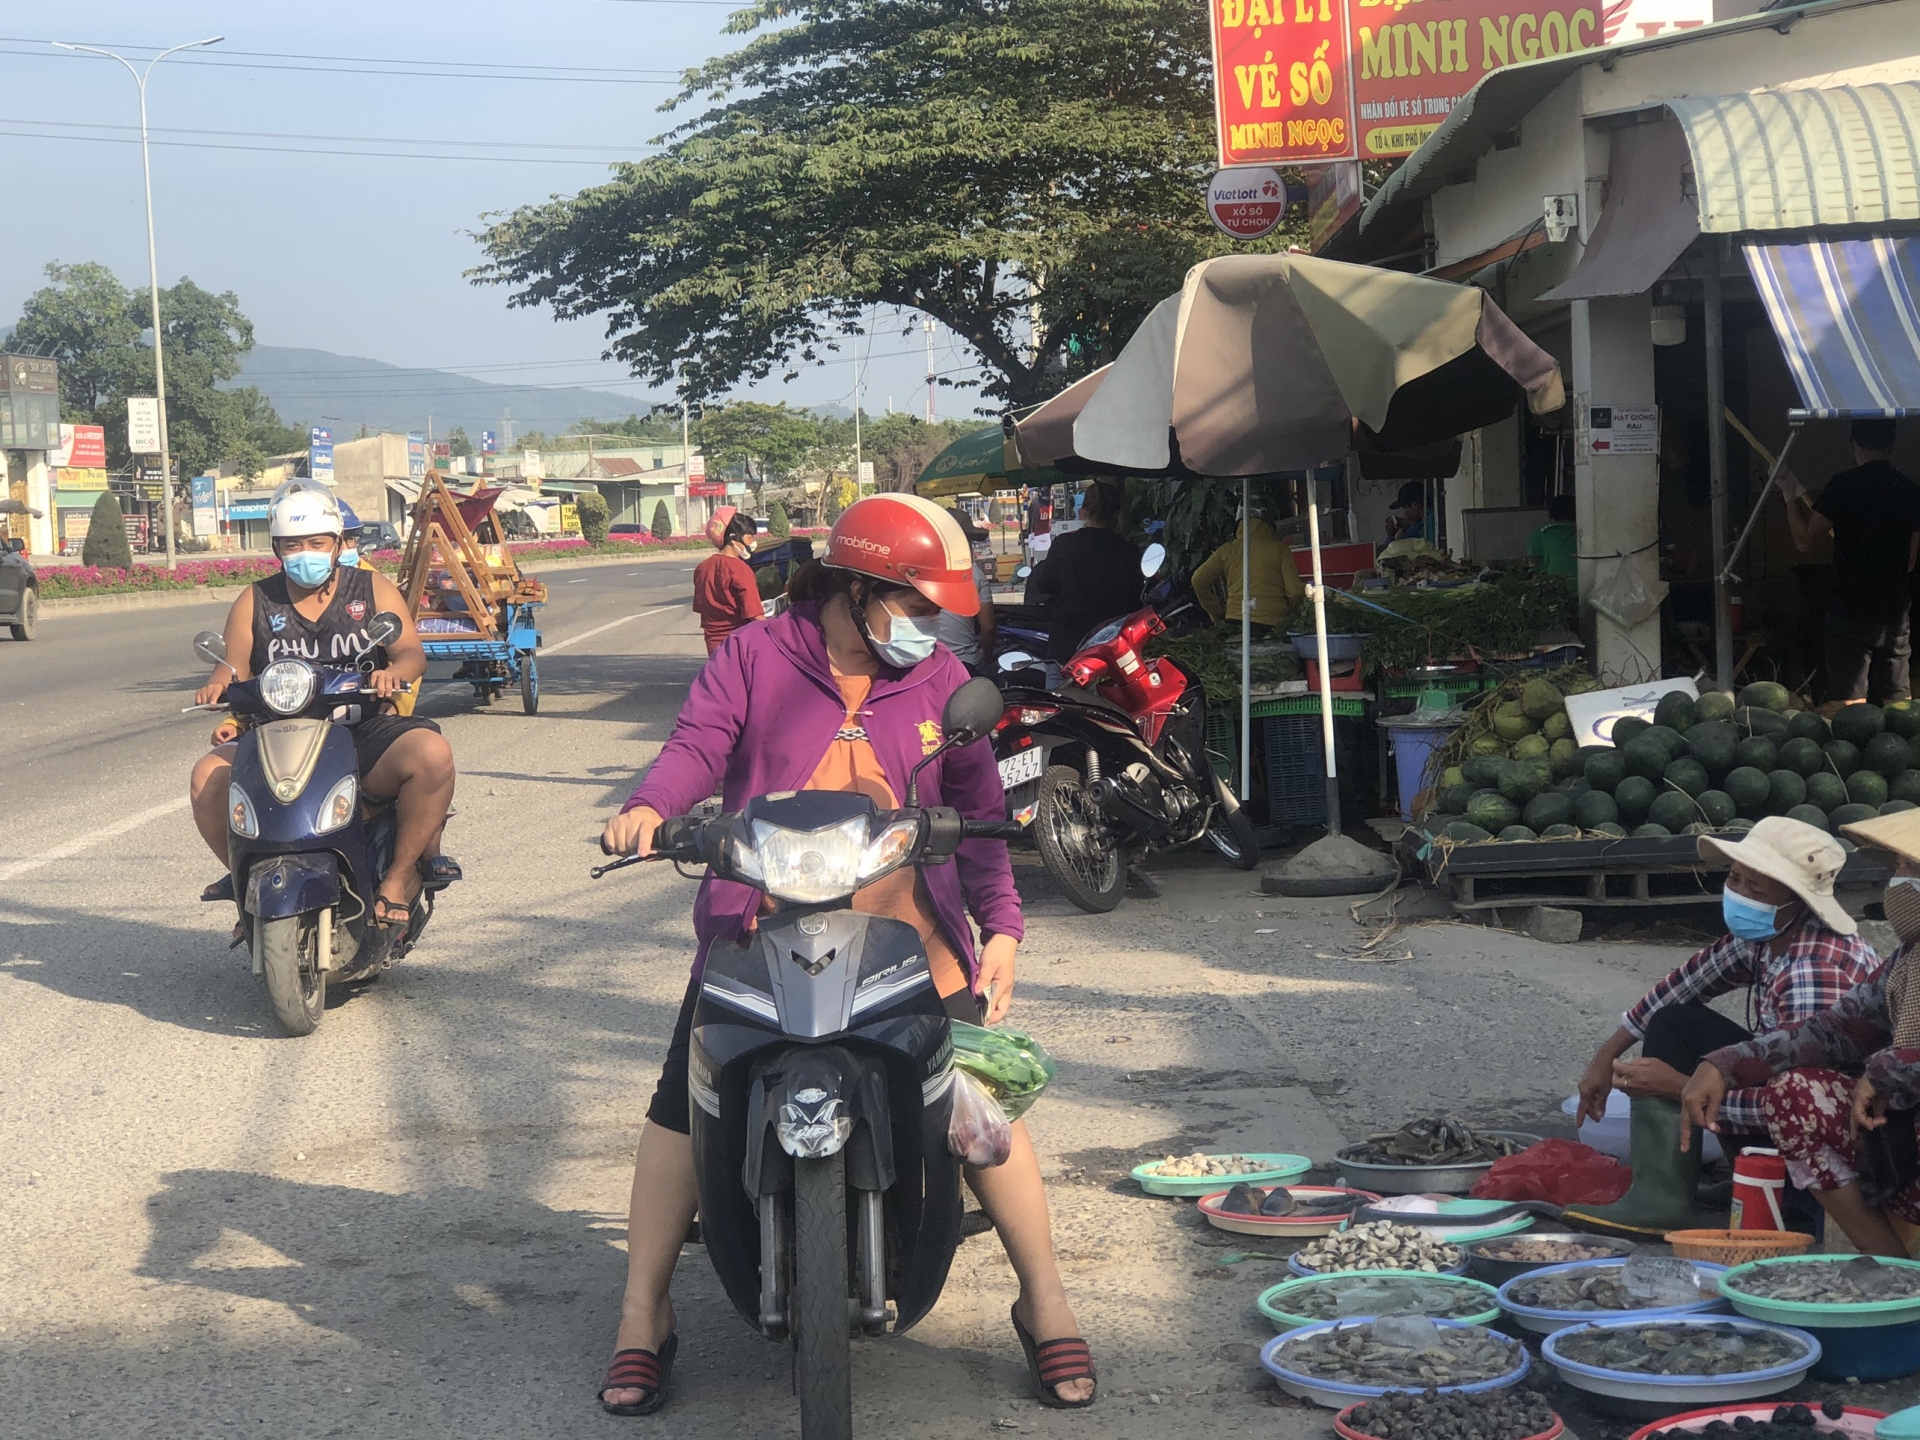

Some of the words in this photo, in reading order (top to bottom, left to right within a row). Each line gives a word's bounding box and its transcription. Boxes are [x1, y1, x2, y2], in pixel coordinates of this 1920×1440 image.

[1359, 18, 1469, 80] MINH
[1234, 50, 1281, 109] VÉ
[1290, 39, 1333, 106] SỐ
[1360, 99, 1383, 122] NHẬN
[1399, 97, 1410, 116] VÉ
[1411, 93, 1422, 116] SỐ
[1230, 122, 1284, 150] MINH
[1287, 117, 1345, 152] NGỌC
[1391, 134, 1404, 149] KHU
[1213, 188, 1258, 201] Vietlott
[1249, 204, 1264, 216] SỐ
[836, 534, 891, 555] mobifone
[269, 612, 287, 633] VS
[1004, 750, 1034, 774] 72-E1
[861, 954, 918, 988] SIRIUS
